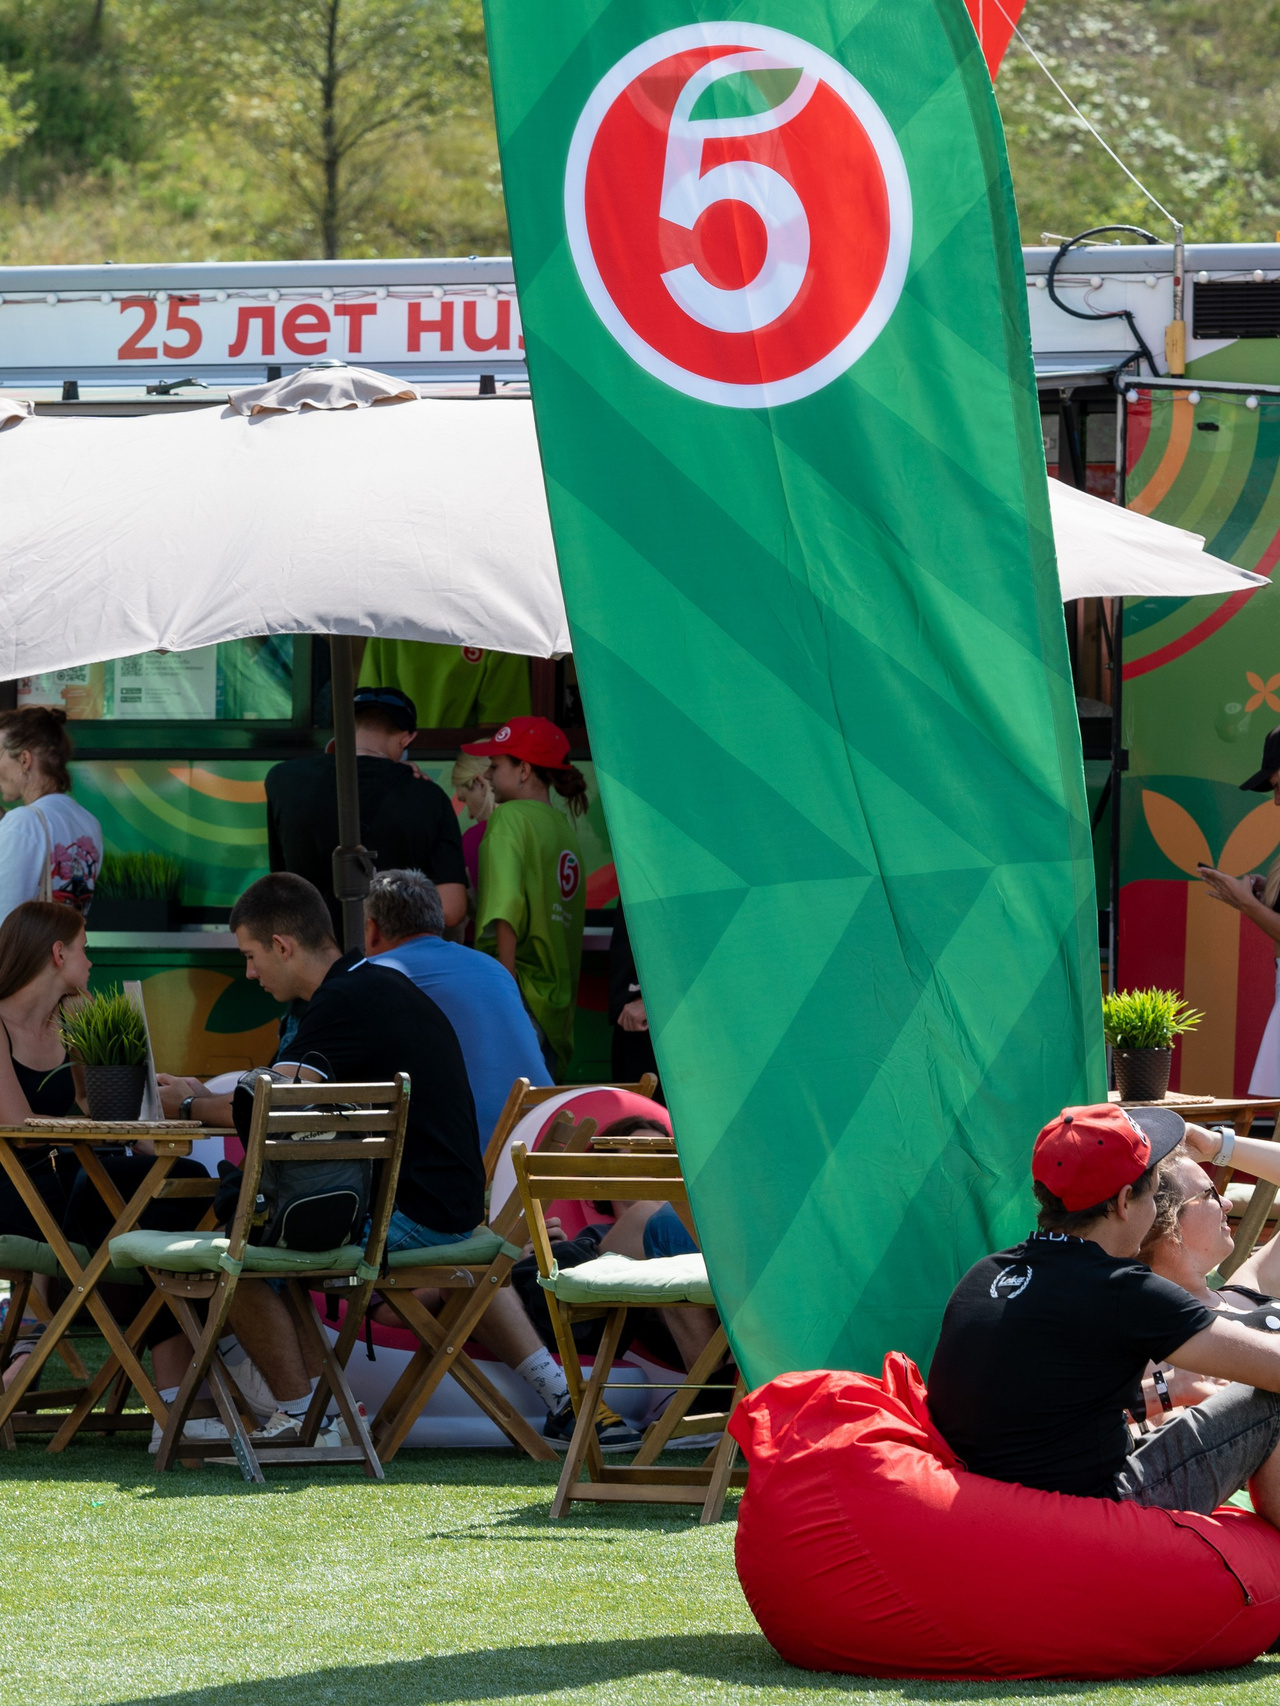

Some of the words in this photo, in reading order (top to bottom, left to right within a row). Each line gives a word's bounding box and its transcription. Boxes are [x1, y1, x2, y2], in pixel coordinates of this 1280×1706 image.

[658, 50, 821, 333] 5
[117, 293, 203, 360] 25
[227, 302, 378, 358] лет
[406, 300, 526, 353] ни
